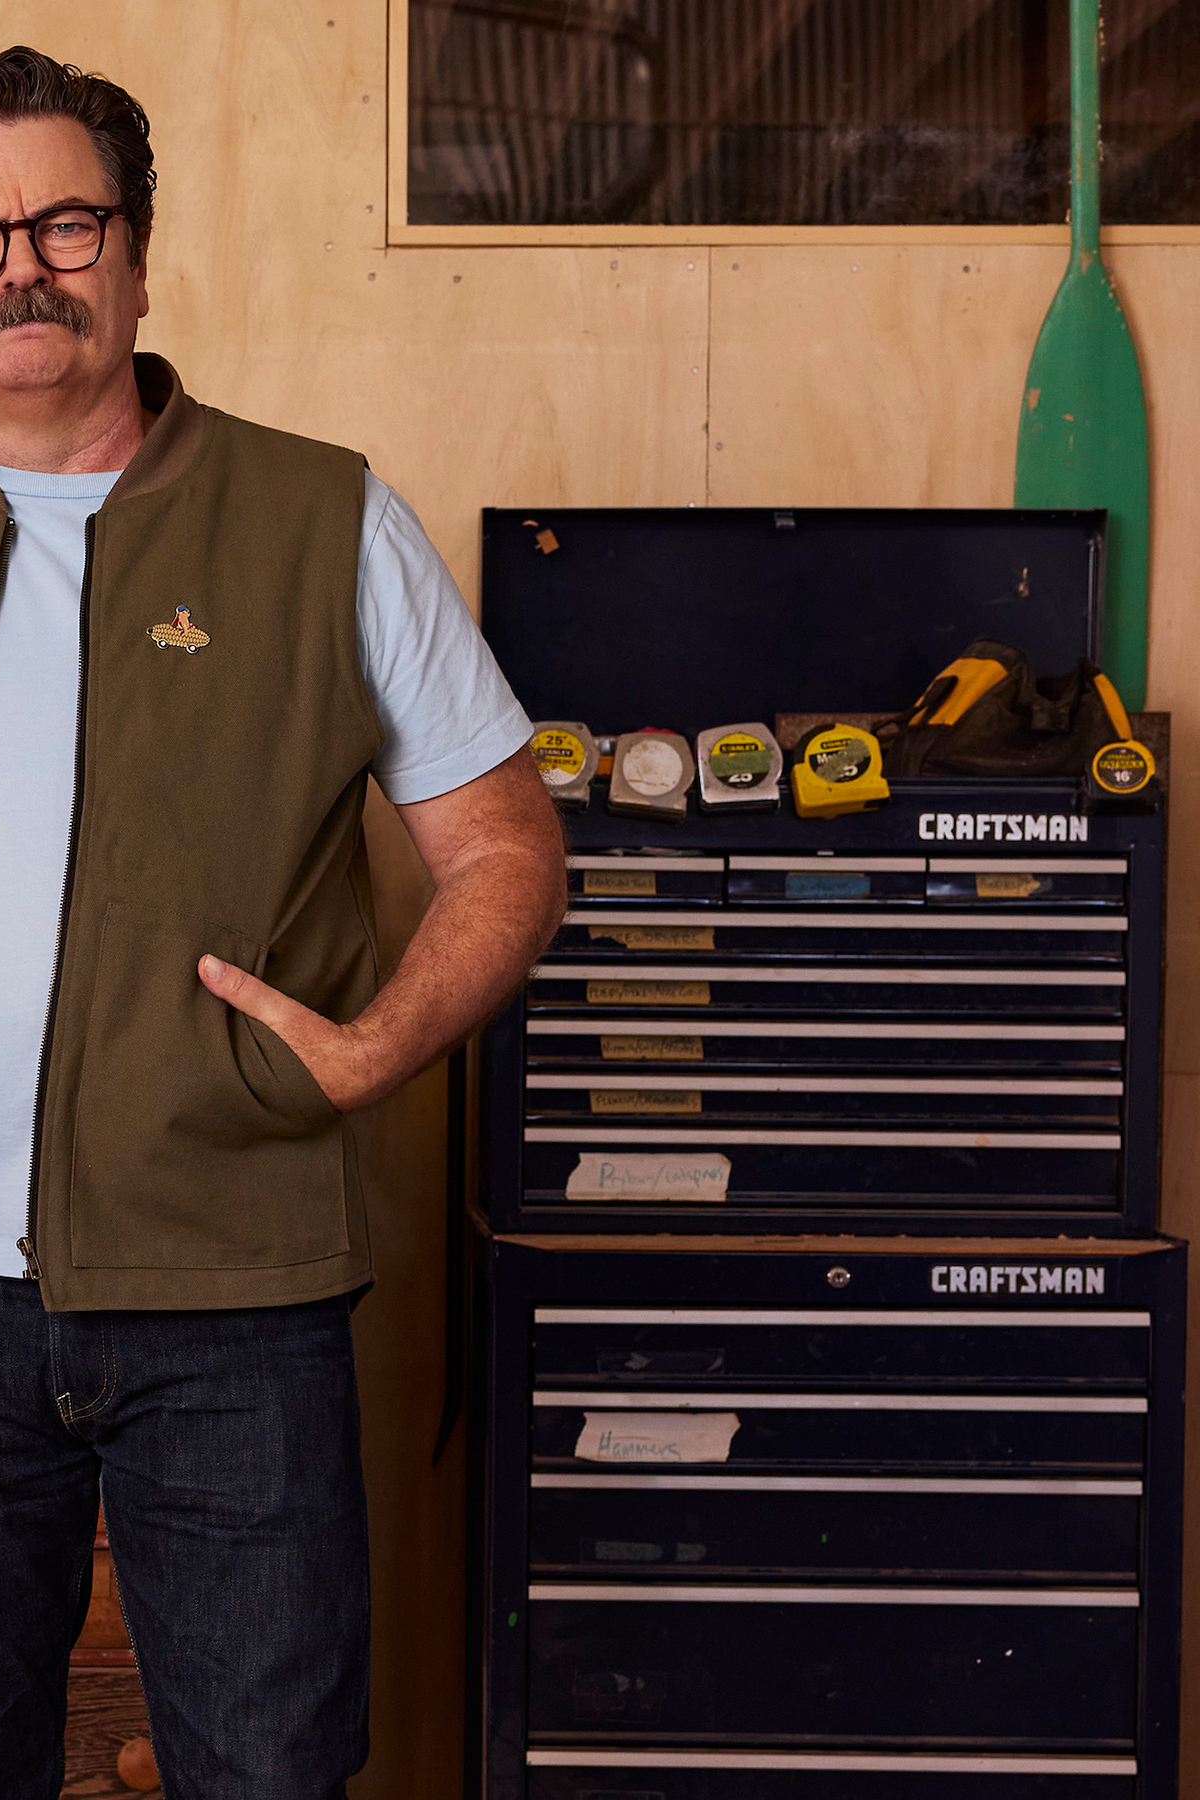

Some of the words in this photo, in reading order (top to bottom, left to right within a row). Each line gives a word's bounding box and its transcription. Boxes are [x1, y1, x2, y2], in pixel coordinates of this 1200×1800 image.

[918, 813, 1088, 841] CRAFTSMAN
[931, 1266, 1105, 1294] CRAFTSMAN
[597, 1430, 681, 1458] Hammers
